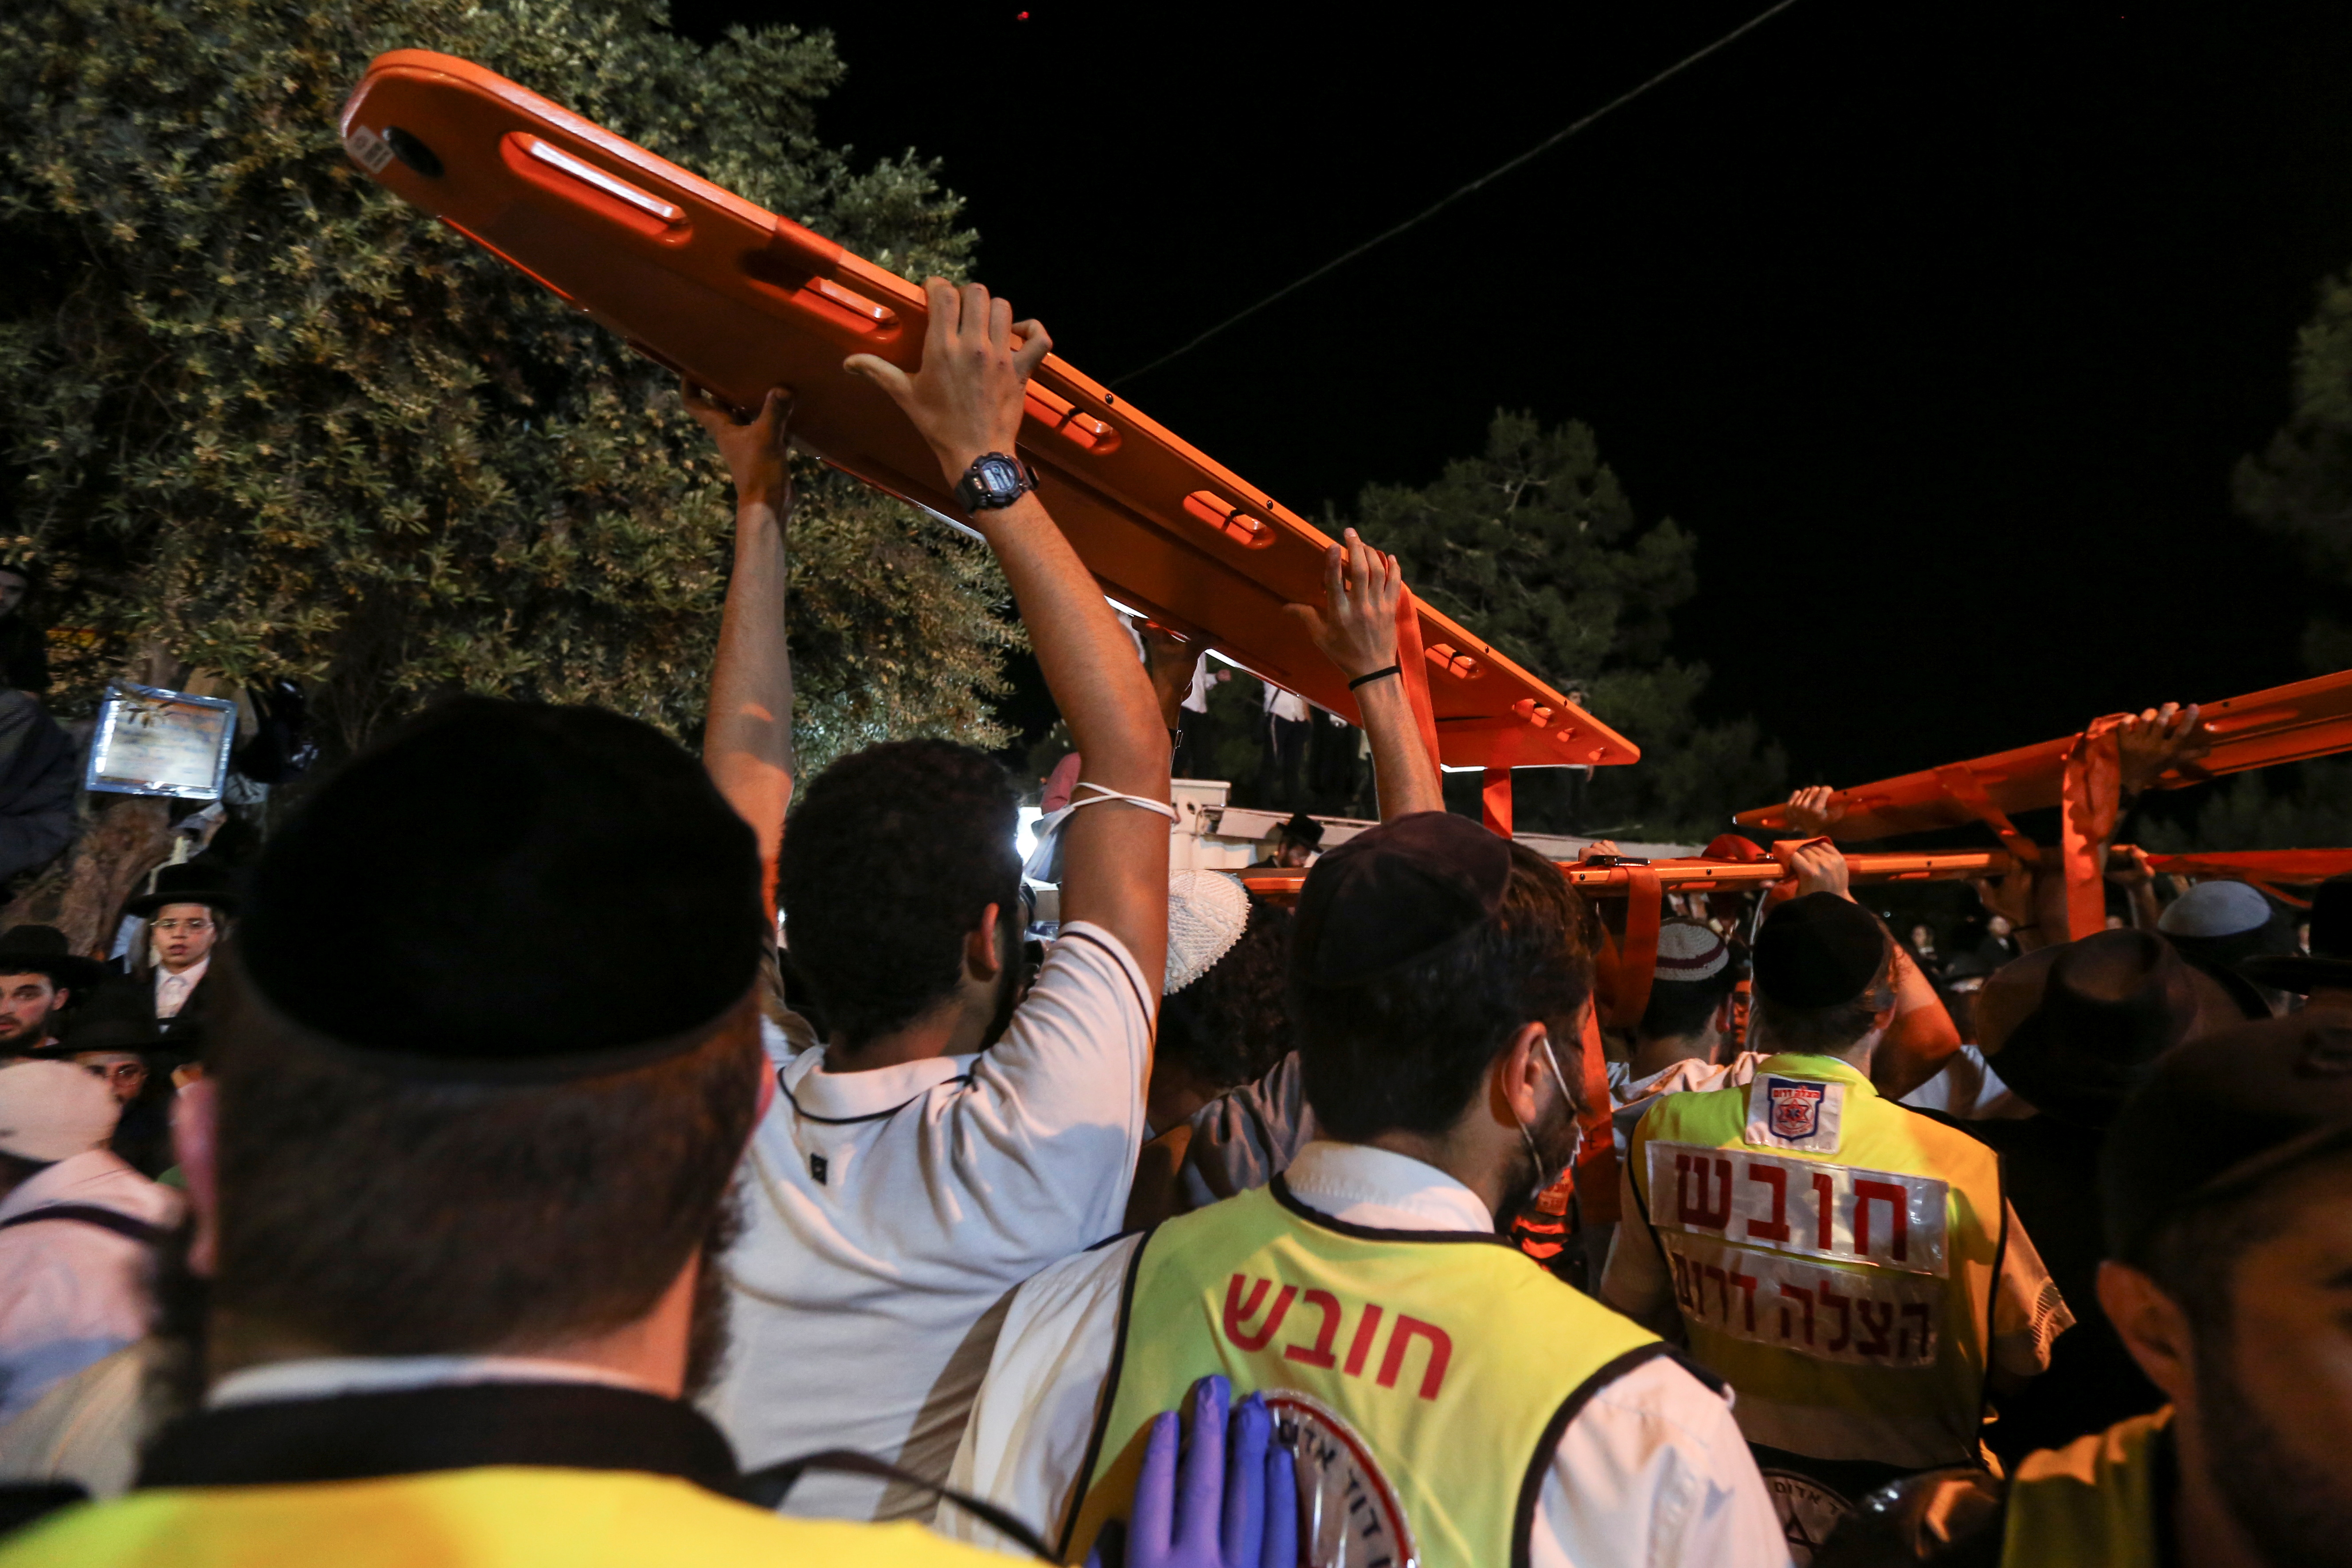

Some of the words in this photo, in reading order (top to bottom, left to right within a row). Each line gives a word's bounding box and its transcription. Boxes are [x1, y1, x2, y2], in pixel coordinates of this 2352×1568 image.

[1676, 1154, 1907, 1262] חובש
[1672, 1252, 1758, 1332] דרום
[1779, 1280, 1929, 1358] הצלה
[1223, 1273, 1453, 1401] חובש
[1344, 1468, 1382, 1538] דוד
[1775, 1482, 1821, 1504] אדום
